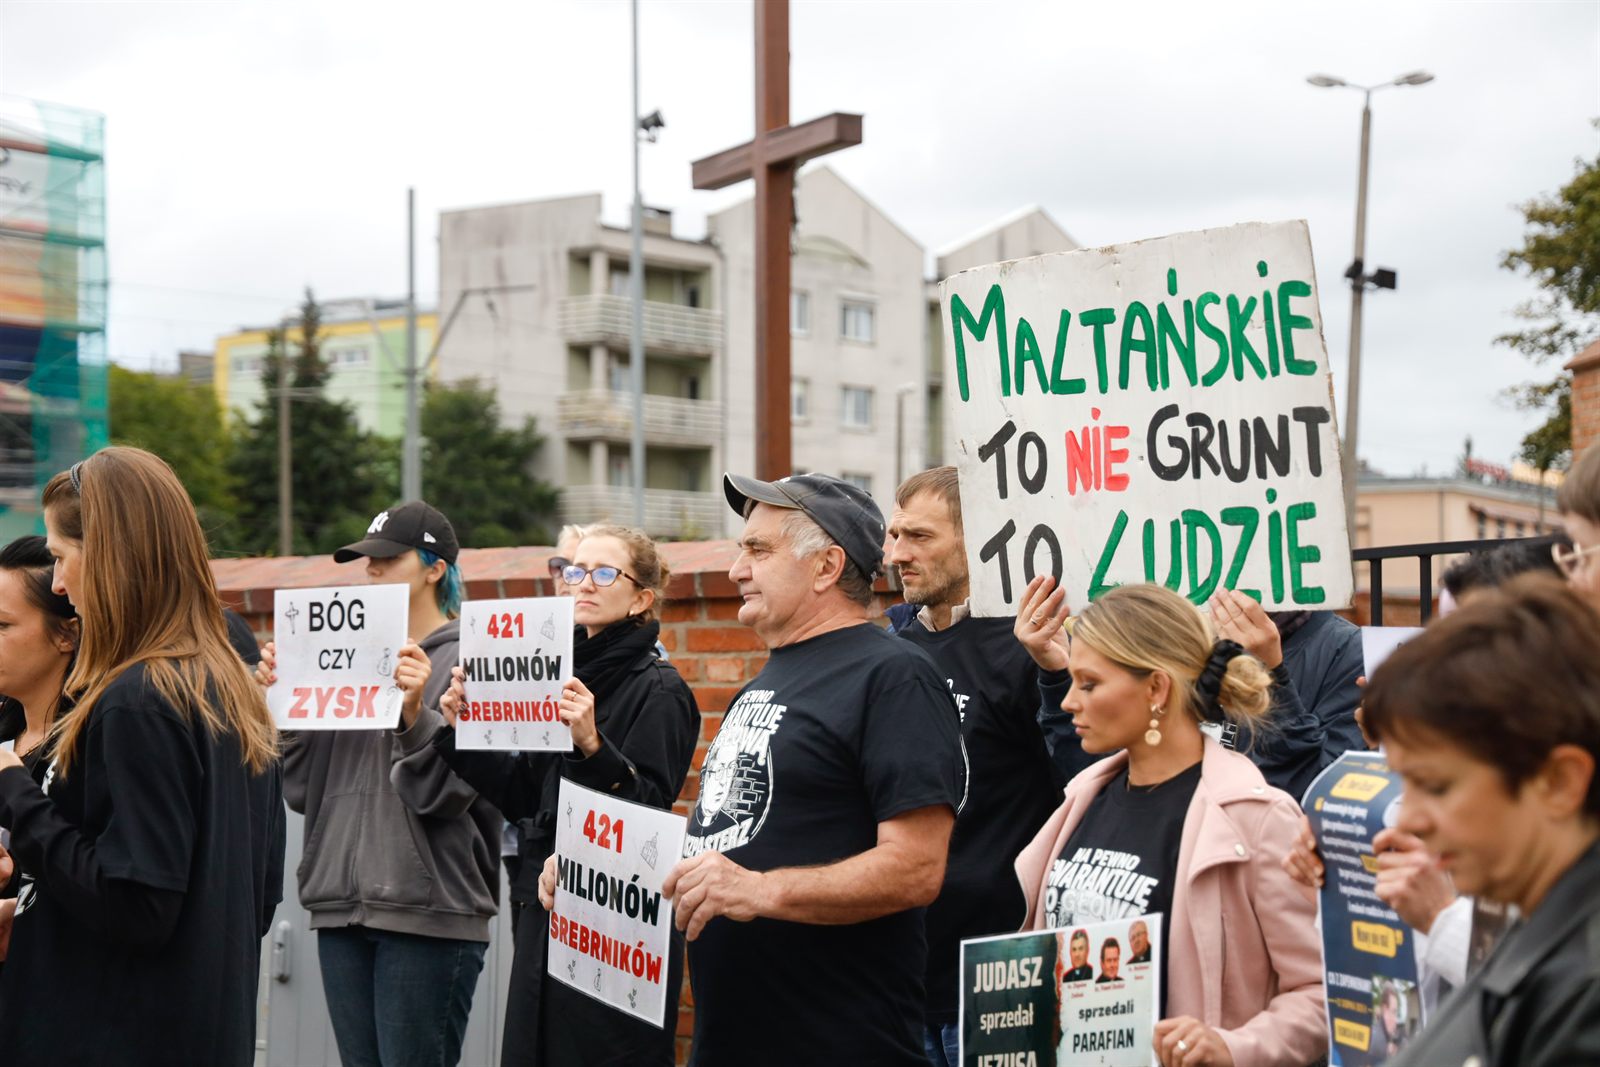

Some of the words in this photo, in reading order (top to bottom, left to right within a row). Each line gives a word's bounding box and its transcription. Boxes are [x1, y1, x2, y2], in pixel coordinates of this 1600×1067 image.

[950, 260, 1318, 402] MALTAŃSKIE
[978, 420, 1047, 499] TO
[1065, 407, 1130, 496] NIE
[1147, 404, 1330, 483] GRUNT
[979, 519, 1063, 604] TO
[1088, 488, 1325, 606] LUDZIE
[309, 592, 365, 632] BÓG
[487, 612, 525, 639] 421
[319, 648, 356, 670] CZY
[463, 648, 562, 682] MILIONÓW
[288, 686, 380, 719] ZYSK
[583, 809, 624, 853] 421
[1071, 847, 1093, 863] NA
[1091, 848, 1141, 871] PEWNO
[556, 854, 661, 927] MILIONÓW
[550, 911, 662, 985] SREBRNIKÓW
[973, 956, 1043, 993] JUDASZ
[980, 1003, 1034, 1034] sprzedał
[1078, 999, 1134, 1022] sprzedali
[1072, 1028, 1135, 1053] PARAFIAN
